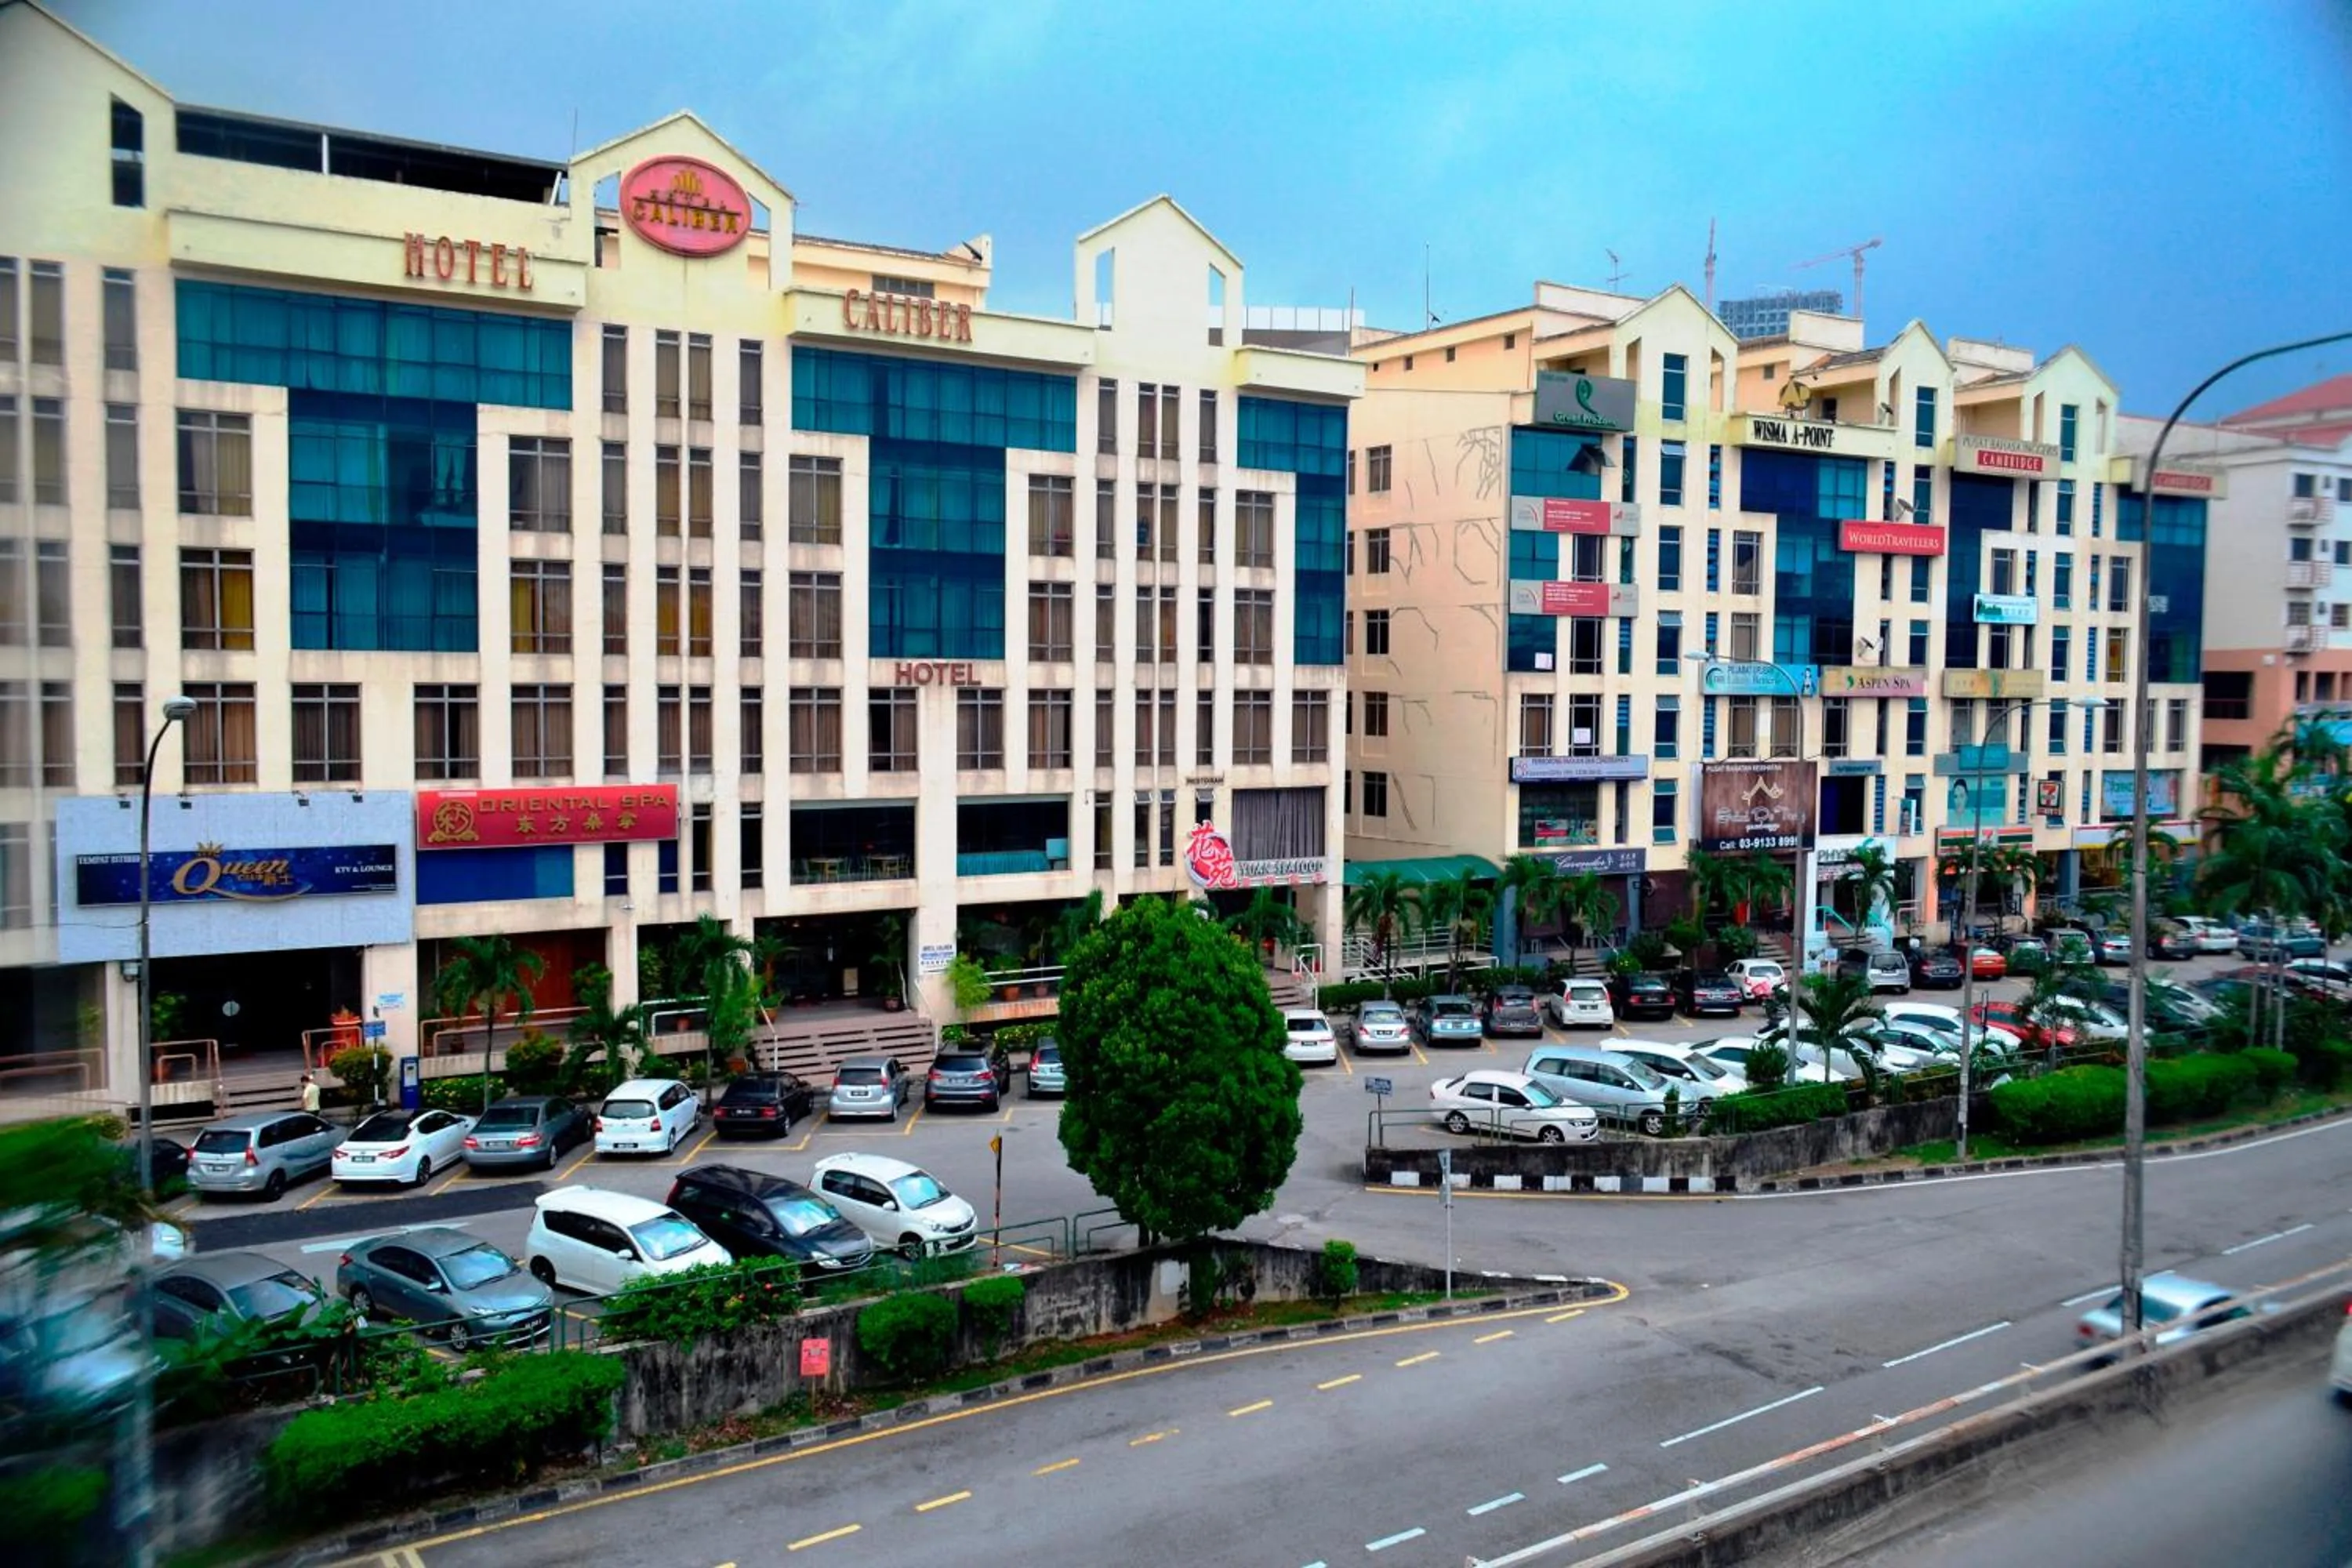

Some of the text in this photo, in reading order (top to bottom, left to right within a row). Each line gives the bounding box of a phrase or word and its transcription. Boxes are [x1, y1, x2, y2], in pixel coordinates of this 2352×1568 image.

[405, 232, 535, 289] HOTEL
[844, 289, 972, 343] CALIBER
[1753, 420, 1835, 448] WISMA A-POINT
[895, 662, 982, 687] HOTEL
[478, 792, 670, 814] ORIENTAL SPA
[172, 856, 290, 895] Queen
